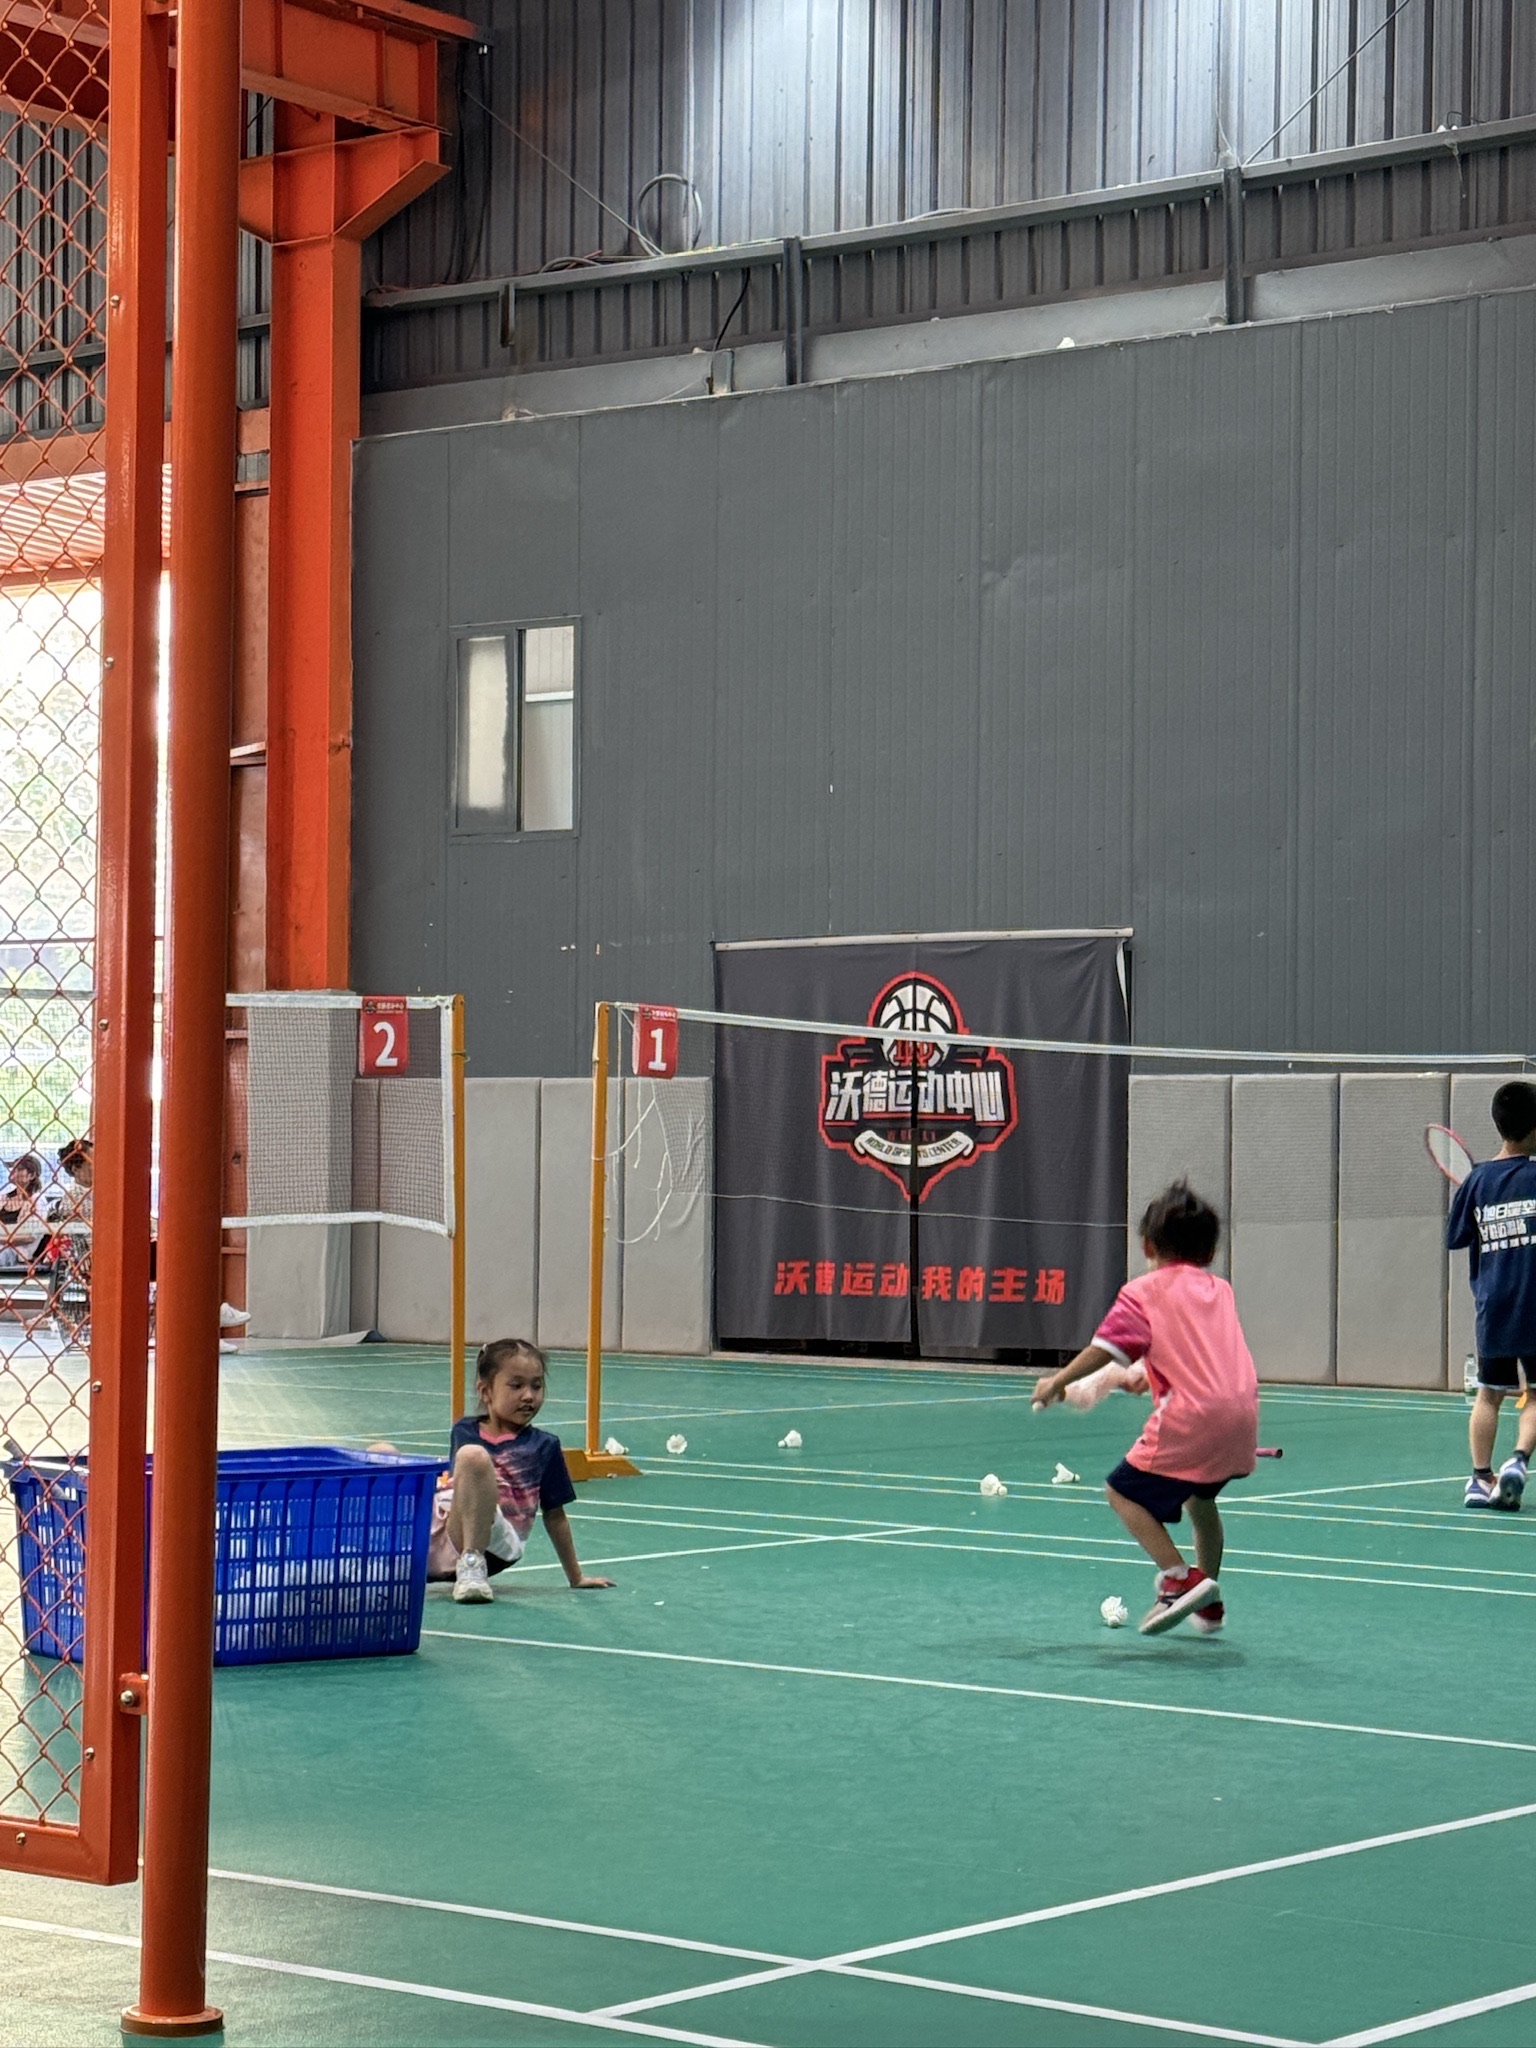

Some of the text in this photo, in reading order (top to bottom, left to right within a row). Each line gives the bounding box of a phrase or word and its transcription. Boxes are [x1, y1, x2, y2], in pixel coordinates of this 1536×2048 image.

[373, 1021, 398, 1067] 2
[648, 1028, 667, 1072] 1
[825, 1070, 1005, 1121] 沃德运动中心
[928, 1138, 963, 1157] CENTER
